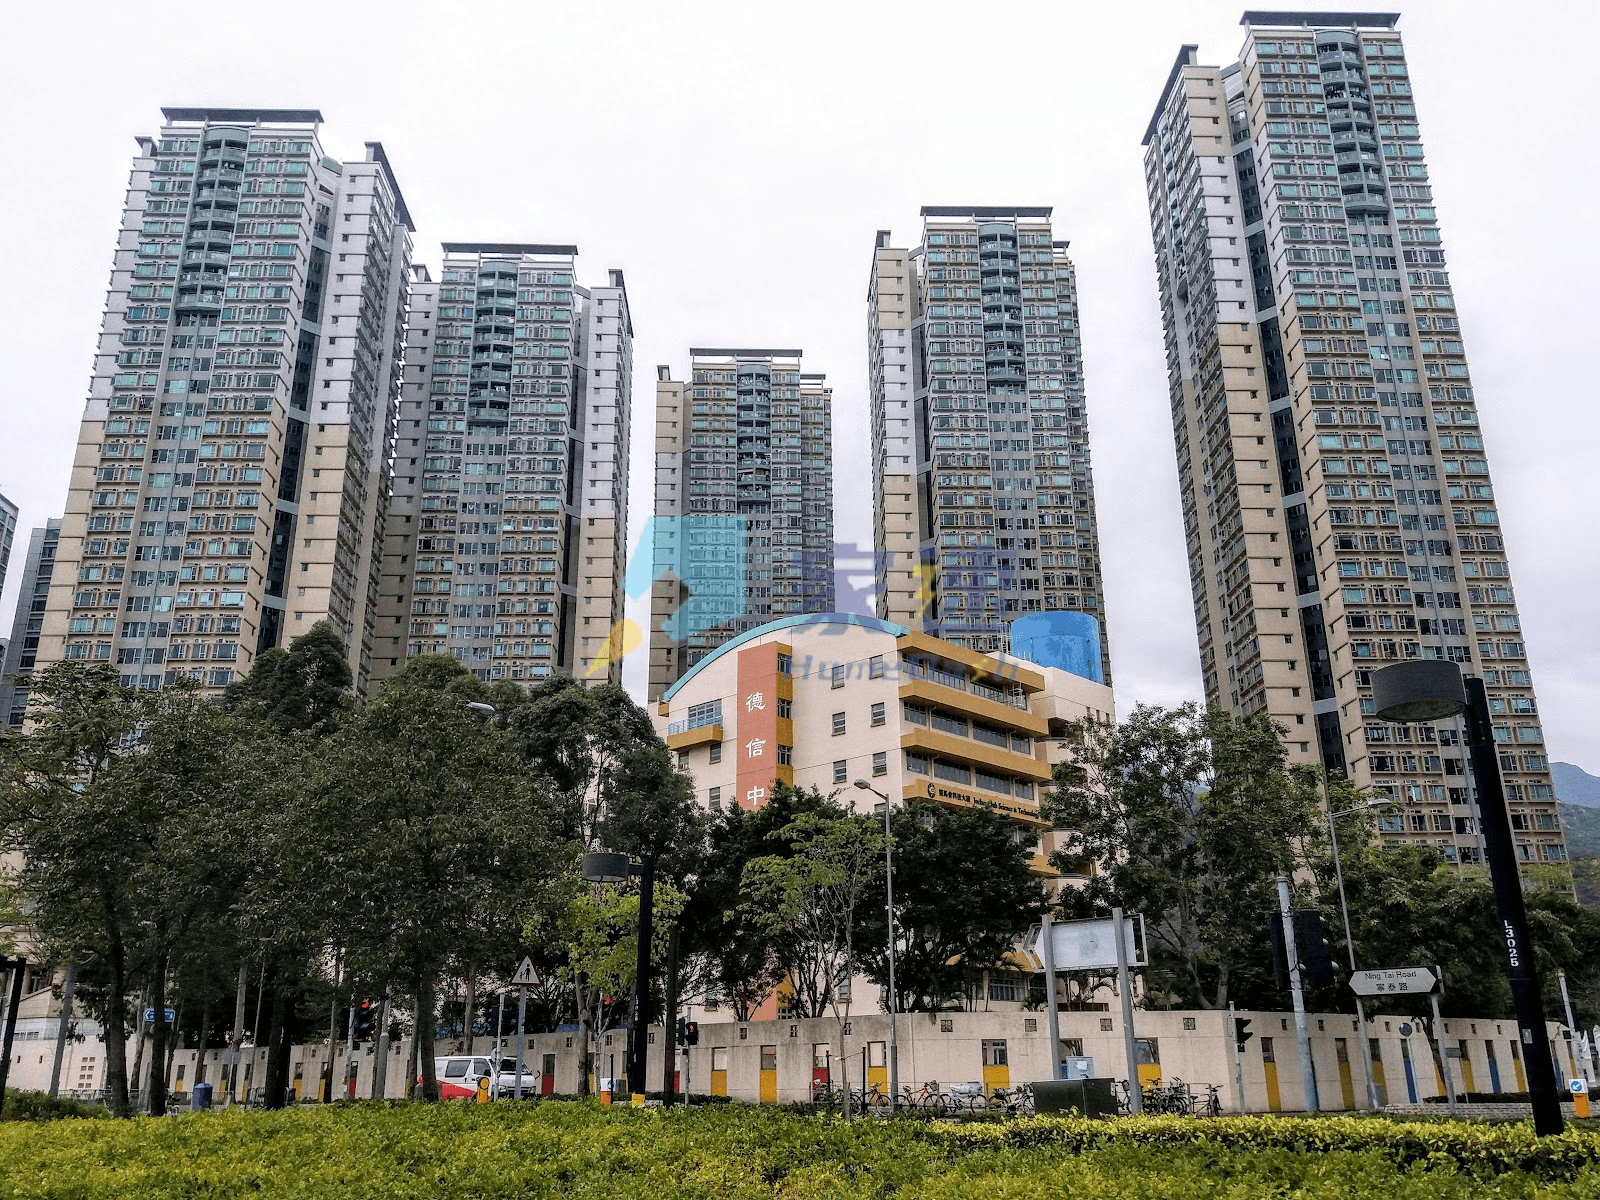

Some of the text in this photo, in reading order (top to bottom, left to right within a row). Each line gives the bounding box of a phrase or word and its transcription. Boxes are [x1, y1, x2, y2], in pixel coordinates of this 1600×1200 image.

[973, 796, 988, 806] Jocke
[1017, 806, 1041, 820] Technolog
[1503, 919, 1520, 967] L3025
[1364, 970, 1417, 981] Ning Tai Road
[1375, 982, 1408, 992] 寧泰路
